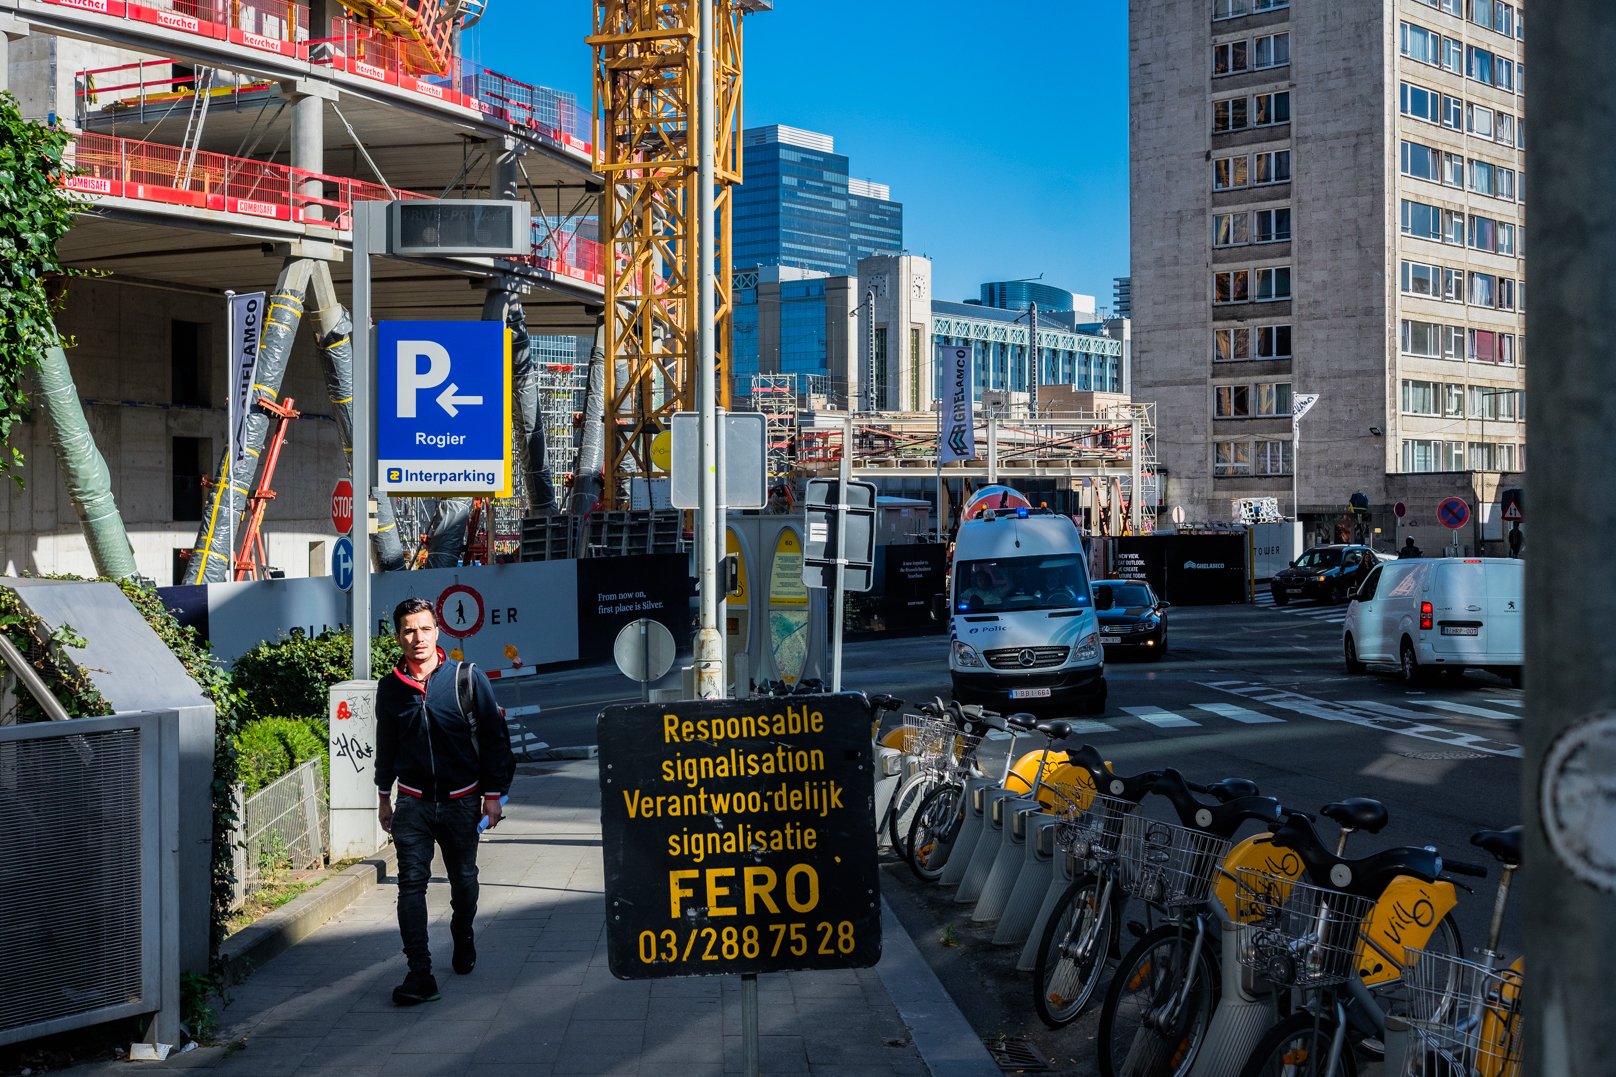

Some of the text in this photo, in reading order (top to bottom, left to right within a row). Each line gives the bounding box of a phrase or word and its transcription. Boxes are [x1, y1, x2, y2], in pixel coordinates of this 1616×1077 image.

[157, 11, 197, 30] kerscher
[244, 34, 279, 51] kerscher
[356, 64, 385, 79] kerscher
[239, 201, 274, 216] COMBISAFE
[397, 340, 451, 418] P
[953, 349, 966, 423] GHELAMCO
[415, 432, 466, 448] Rogier
[405, 469, 495, 485] Interparking
[1253, 546, 1280, 556] TOWER
[618, 592, 634, 600] now
[598, 600, 664, 614] first place is Silver.
[982, 625, 1013, 633] Police
[664, 705, 824, 747] Responsable
[662, 746, 824, 788] signalisation
[623, 780, 844, 818] Verantwoordelijk
[668, 822, 817, 862] signalisatie
[669, 863, 820, 918] FERO
[638, 920, 856, 964] 03/288 75 28
